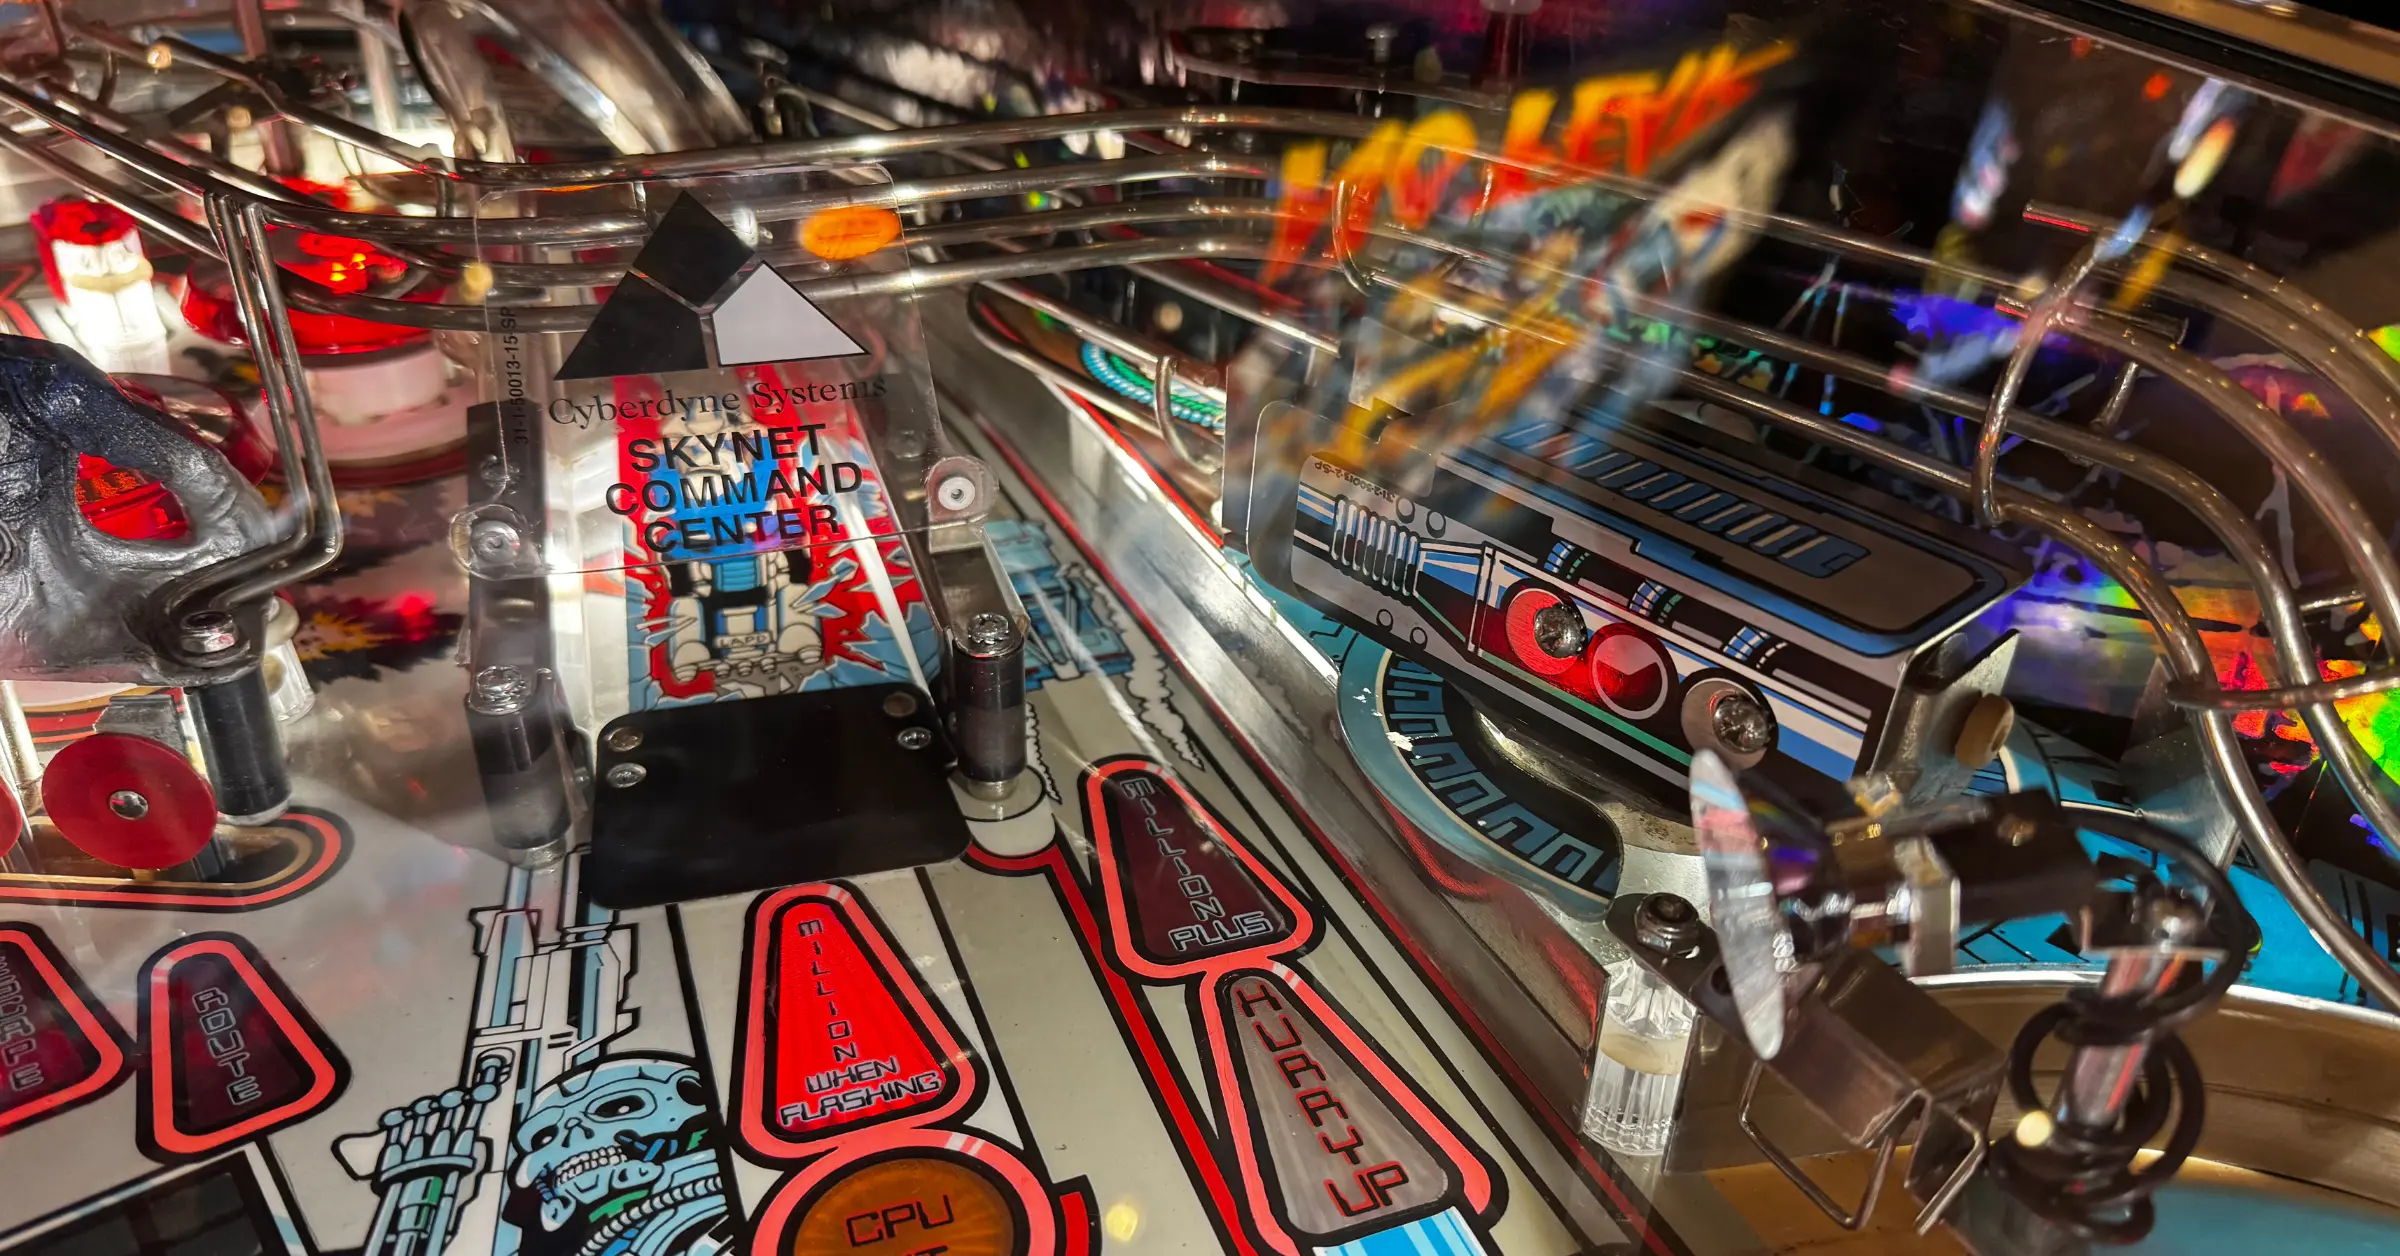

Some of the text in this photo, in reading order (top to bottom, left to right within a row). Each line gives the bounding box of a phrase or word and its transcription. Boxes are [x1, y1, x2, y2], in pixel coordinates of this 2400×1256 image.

[549, 377, 888, 428] Cyberdyne Systems
[628, 423, 828, 473] SKYNET
[606, 462, 864, 516] COMMAND
[644, 505, 840, 554] CENTER
[1120, 777, 1273, 953] MILLION PLUS
[798, 919, 860, 1064] MILLION
[191, 986, 264, 1107] ROUTE
[779, 1071, 942, 1128] FLASHING
[804, 1055, 902, 1095] WHEN
[1236, 982, 1410, 1217] HURRY UP
[845, 1194, 956, 1248] CPU
